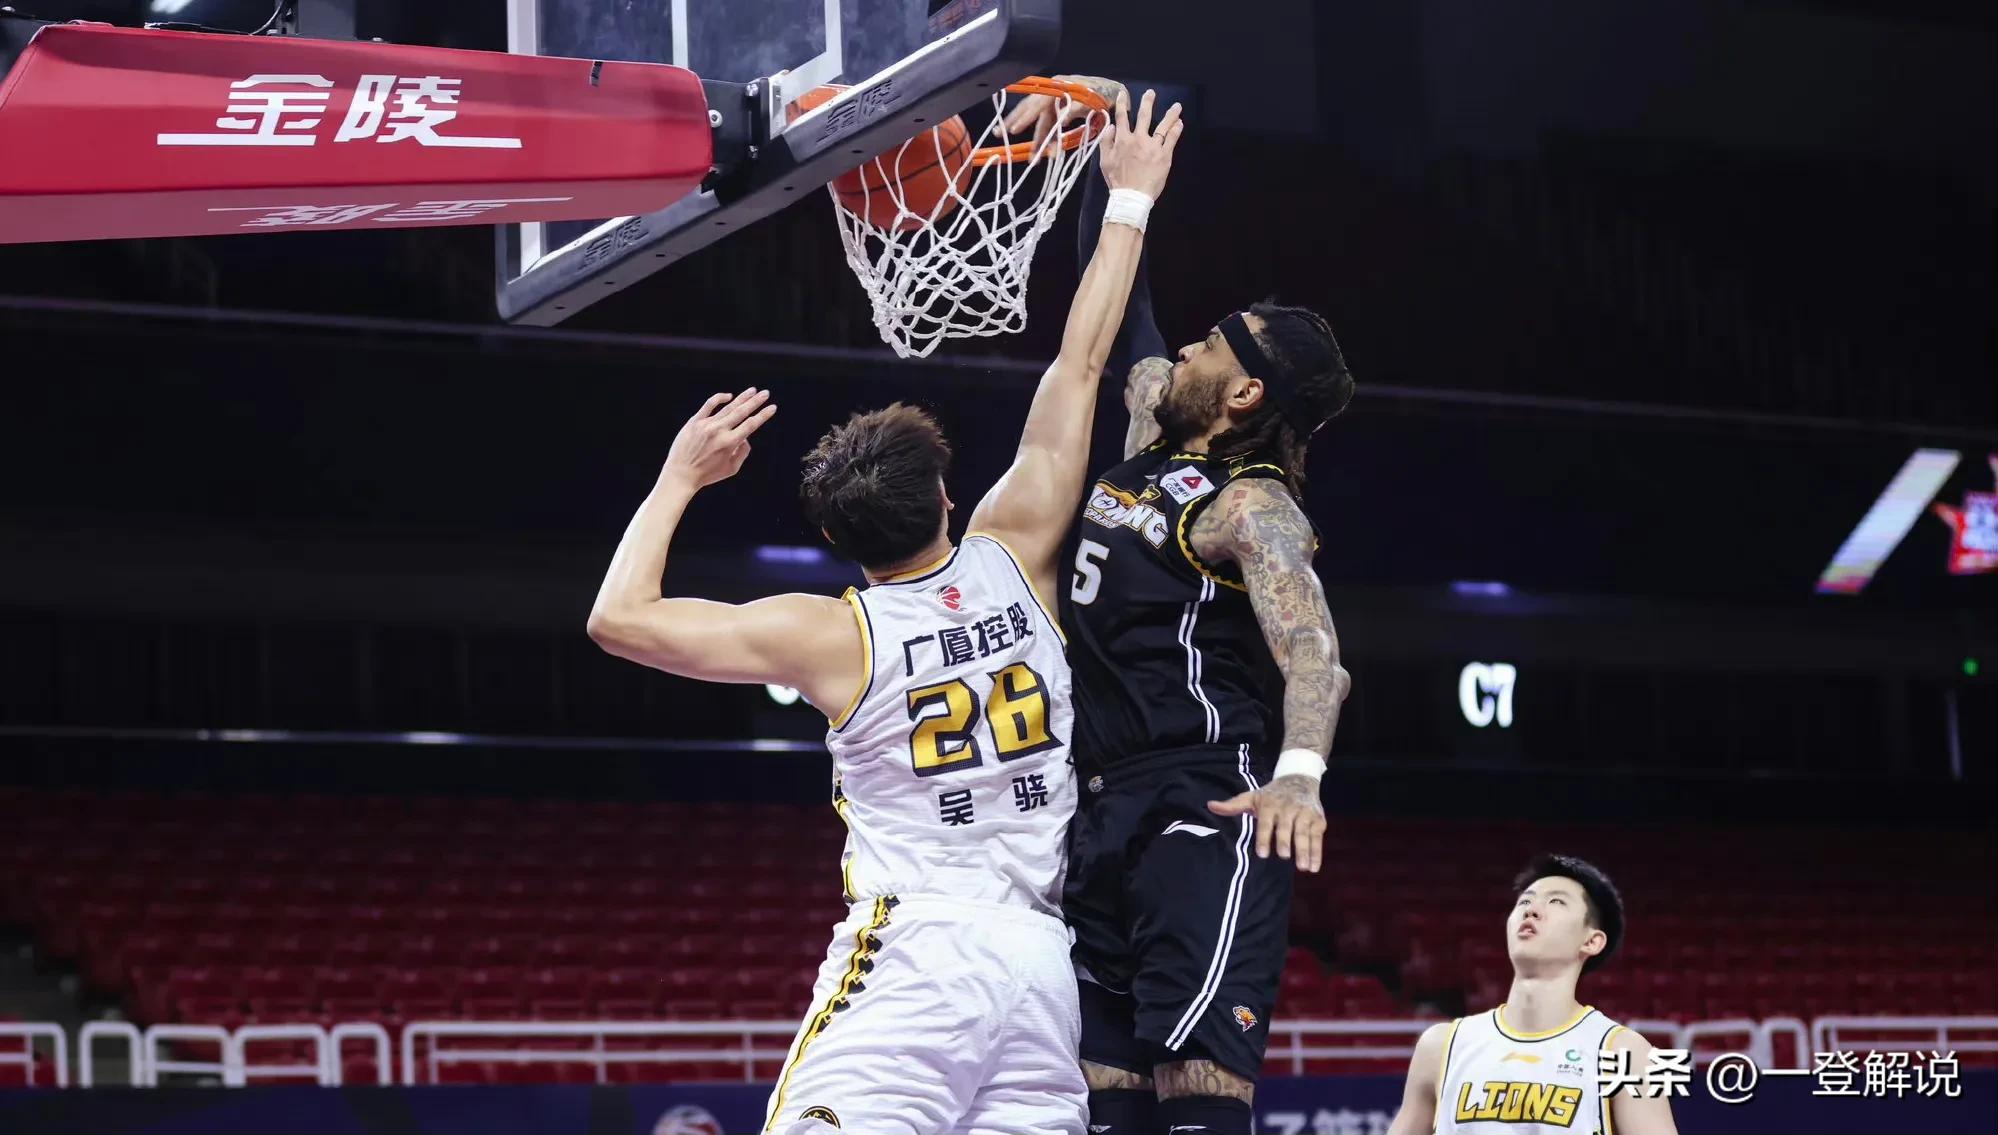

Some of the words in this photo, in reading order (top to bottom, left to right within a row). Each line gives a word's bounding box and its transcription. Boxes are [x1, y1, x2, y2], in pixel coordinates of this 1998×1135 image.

[157, 74, 522, 148] 金陵
[207, 197, 573, 227] 金陵
[1071, 538, 1110, 606] 5
[902, 601, 1034, 677] 广厦控股
[905, 660, 1065, 778] 26
[1459, 661, 1517, 728] C7
[939, 774, 1048, 826] 吴骁
[1455, 1081, 1584, 1128] LIONS
